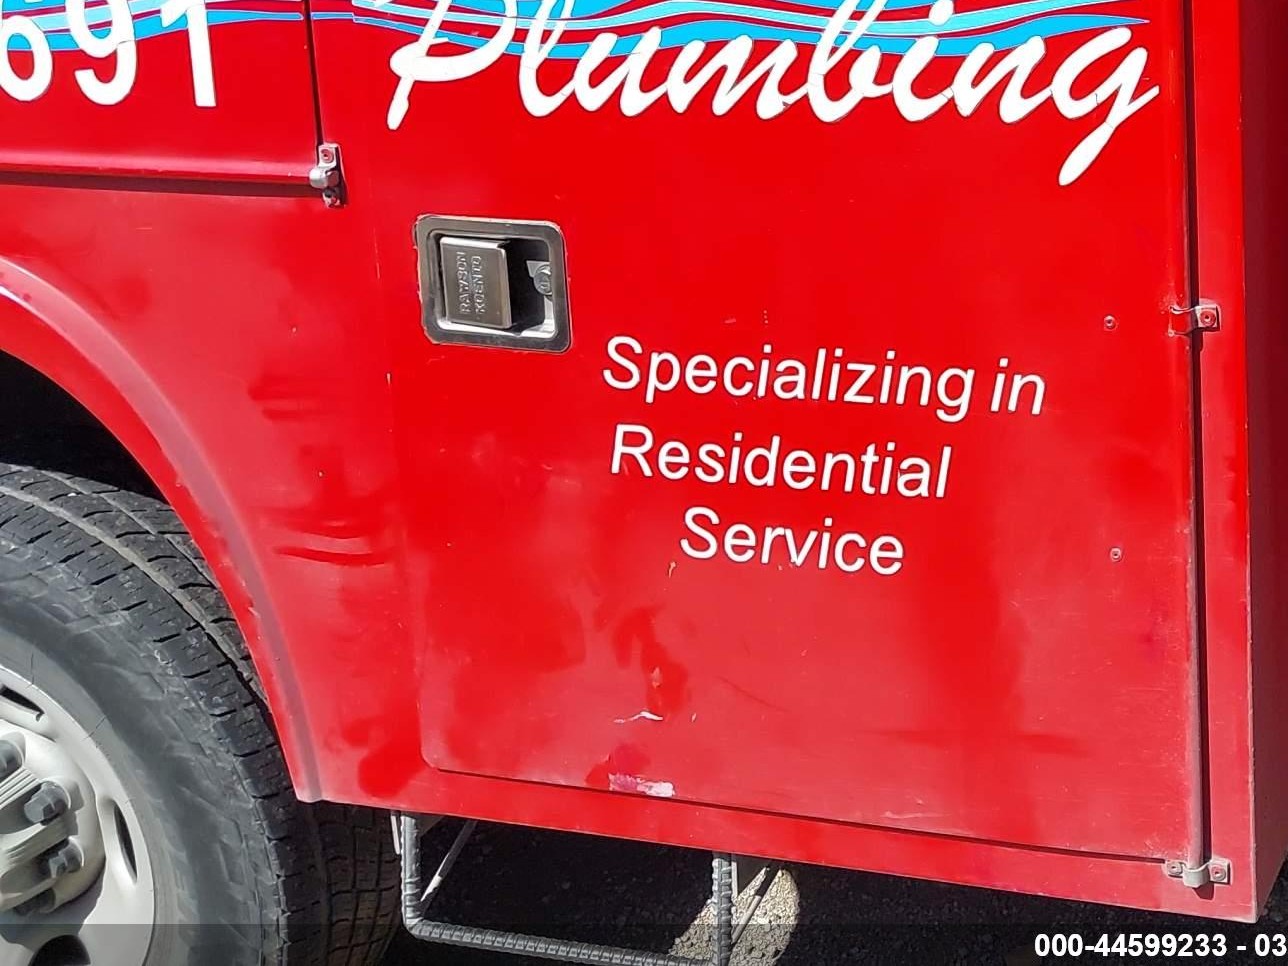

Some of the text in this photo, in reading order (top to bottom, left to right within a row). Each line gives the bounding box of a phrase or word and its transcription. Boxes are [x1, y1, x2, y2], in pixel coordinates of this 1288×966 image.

[602, 335, 1046, 424] Specializing in
[610, 423, 953, 499] Residential
[679, 505, 904, 576] Service
